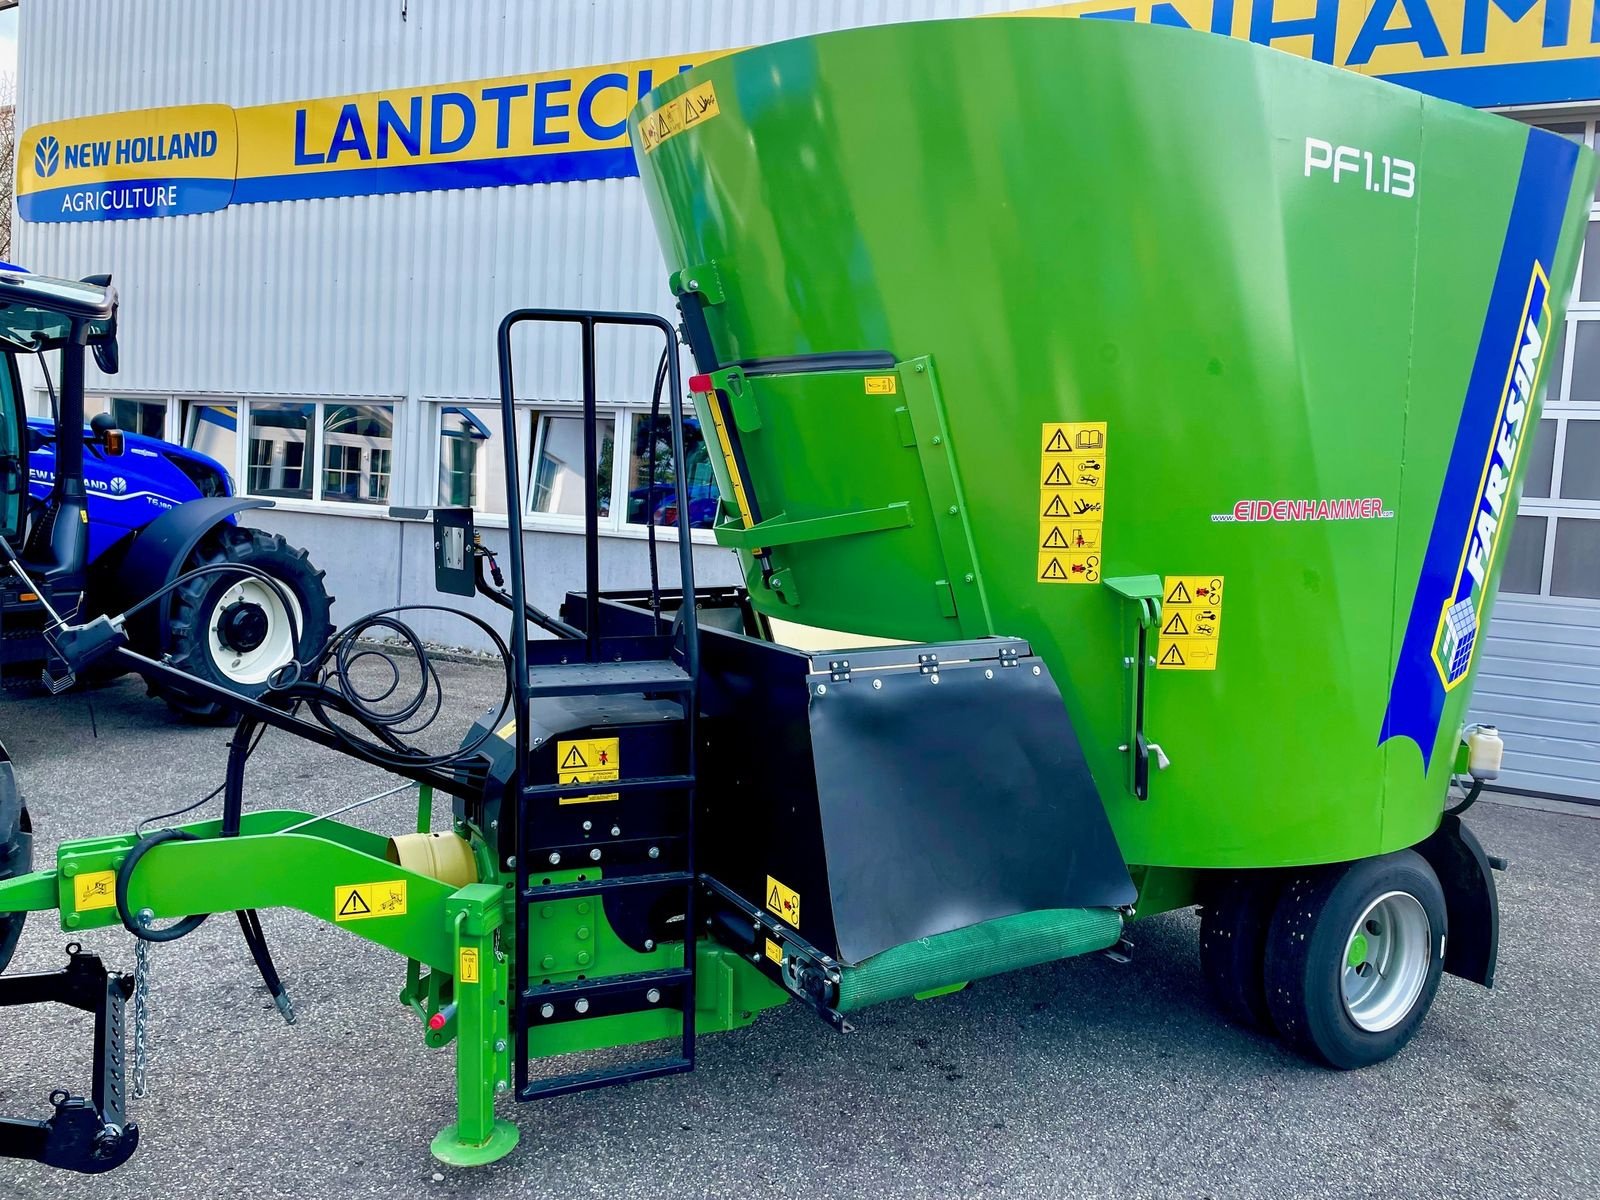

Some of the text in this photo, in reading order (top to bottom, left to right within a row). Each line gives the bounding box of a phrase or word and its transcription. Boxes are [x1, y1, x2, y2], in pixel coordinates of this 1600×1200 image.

[1079, 0, 1600, 66] HAM
[64, 130, 218, 170] NEW HOLLAND
[1304, 136, 1416, 198] PF1.13
[61, 185, 177, 213] AGRICULTURE
[29, 468, 48, 480] EW
[1466, 314, 1543, 589] FARESIN
